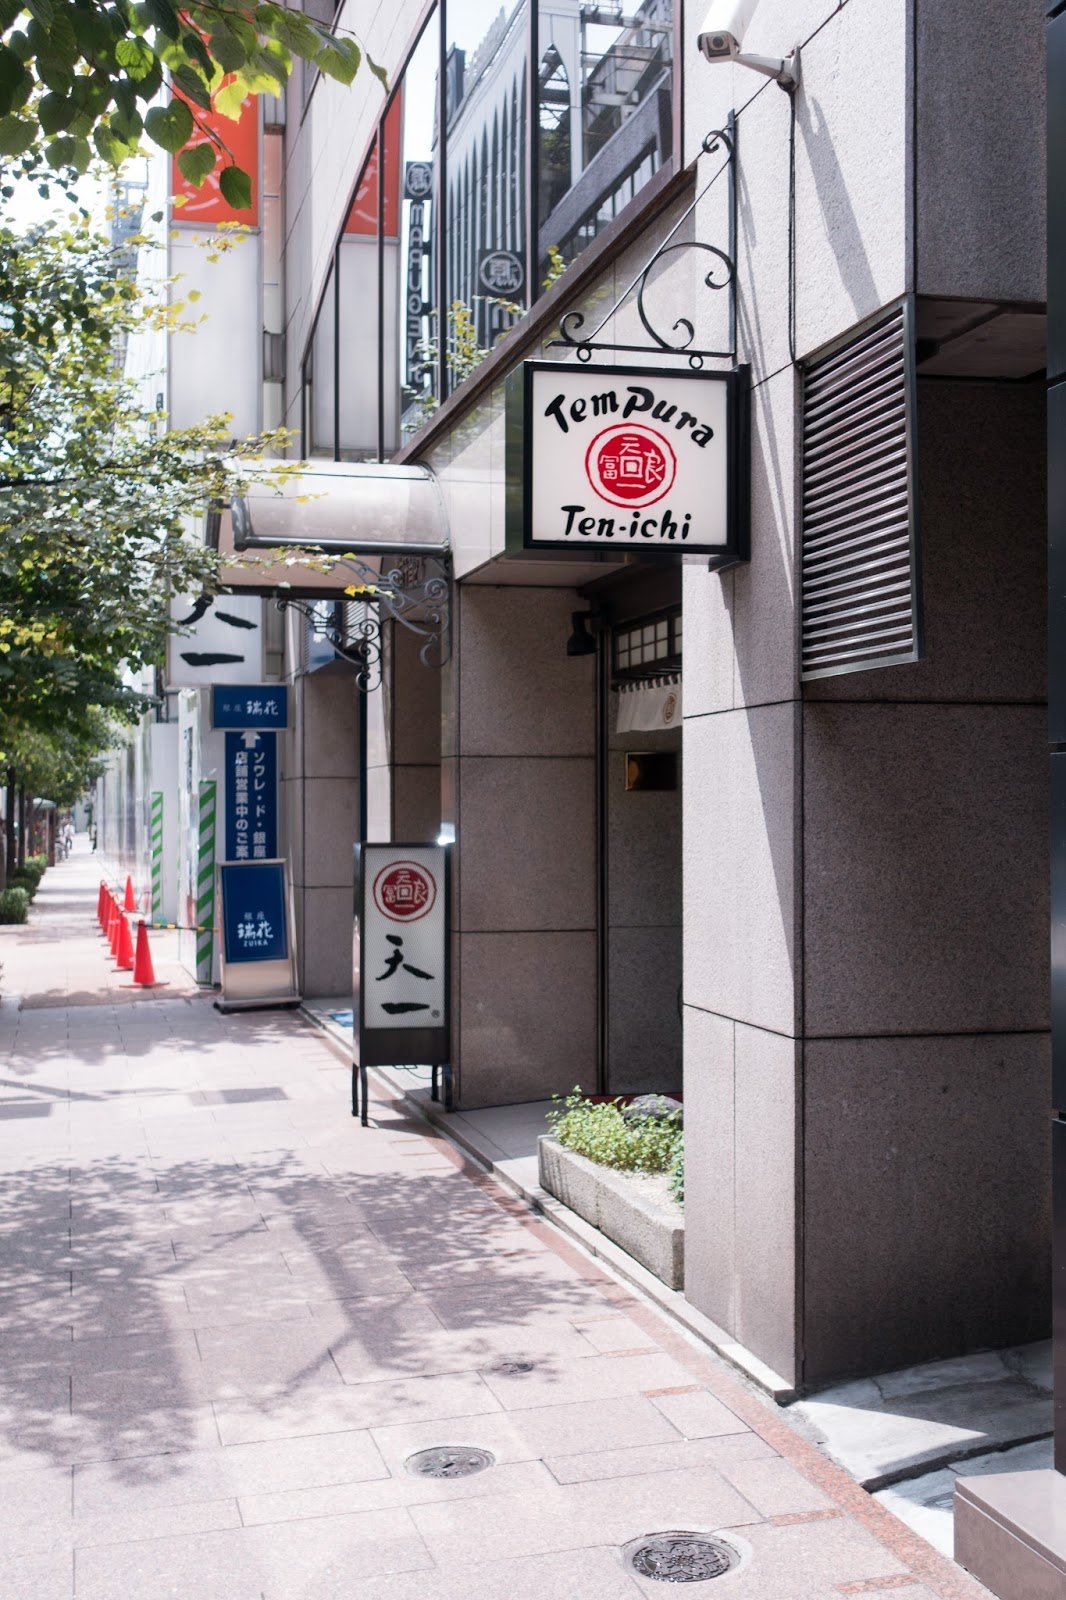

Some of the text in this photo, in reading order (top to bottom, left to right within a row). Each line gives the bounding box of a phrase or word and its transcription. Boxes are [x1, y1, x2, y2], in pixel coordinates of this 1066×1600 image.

[560, 505, 692, 540] Ten-ichi
[234, 751, 249, 860] 店舗営業中のご案
[243, 939, 269, 947] ZUIKA
